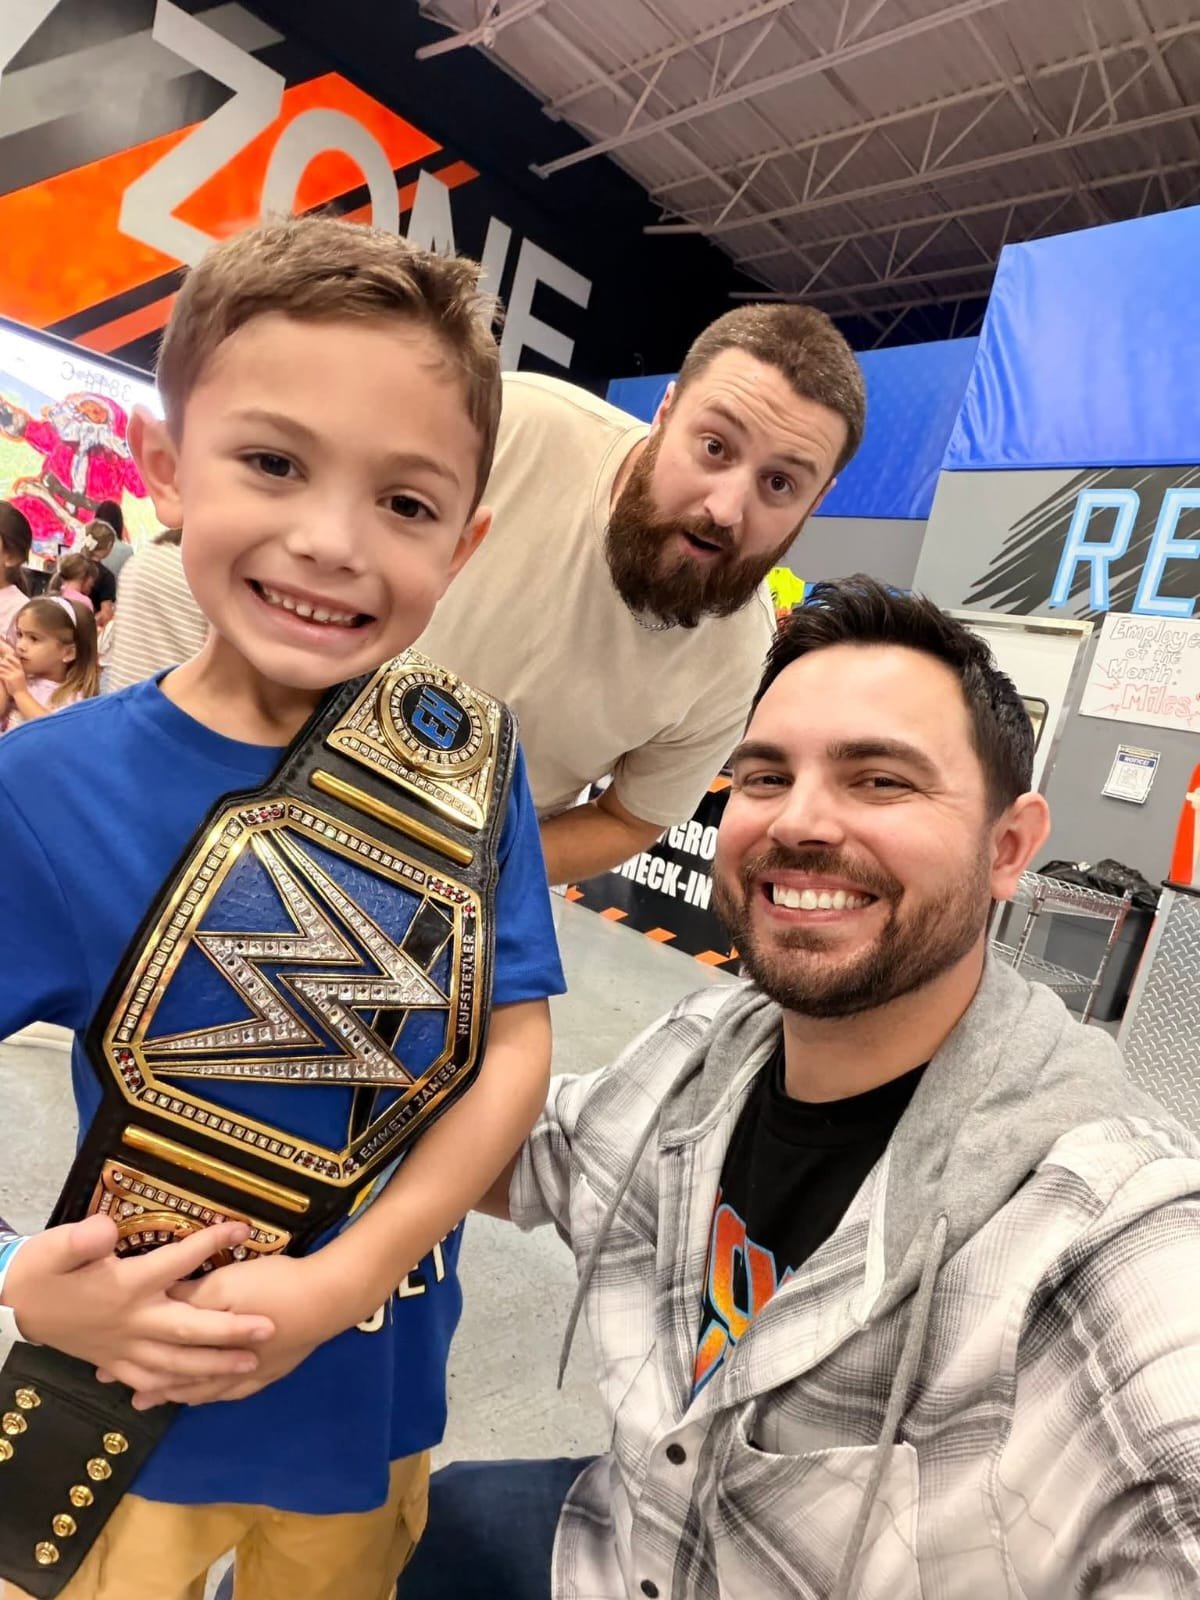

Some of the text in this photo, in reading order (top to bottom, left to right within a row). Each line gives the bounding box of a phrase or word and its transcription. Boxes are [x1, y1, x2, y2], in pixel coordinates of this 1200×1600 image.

[1125, 647, 1149, 661] of
[610, 851, 713, 910] HECK-IN
[360, 934, 475, 1159] EMMETT JAMES HUFSTETLER
